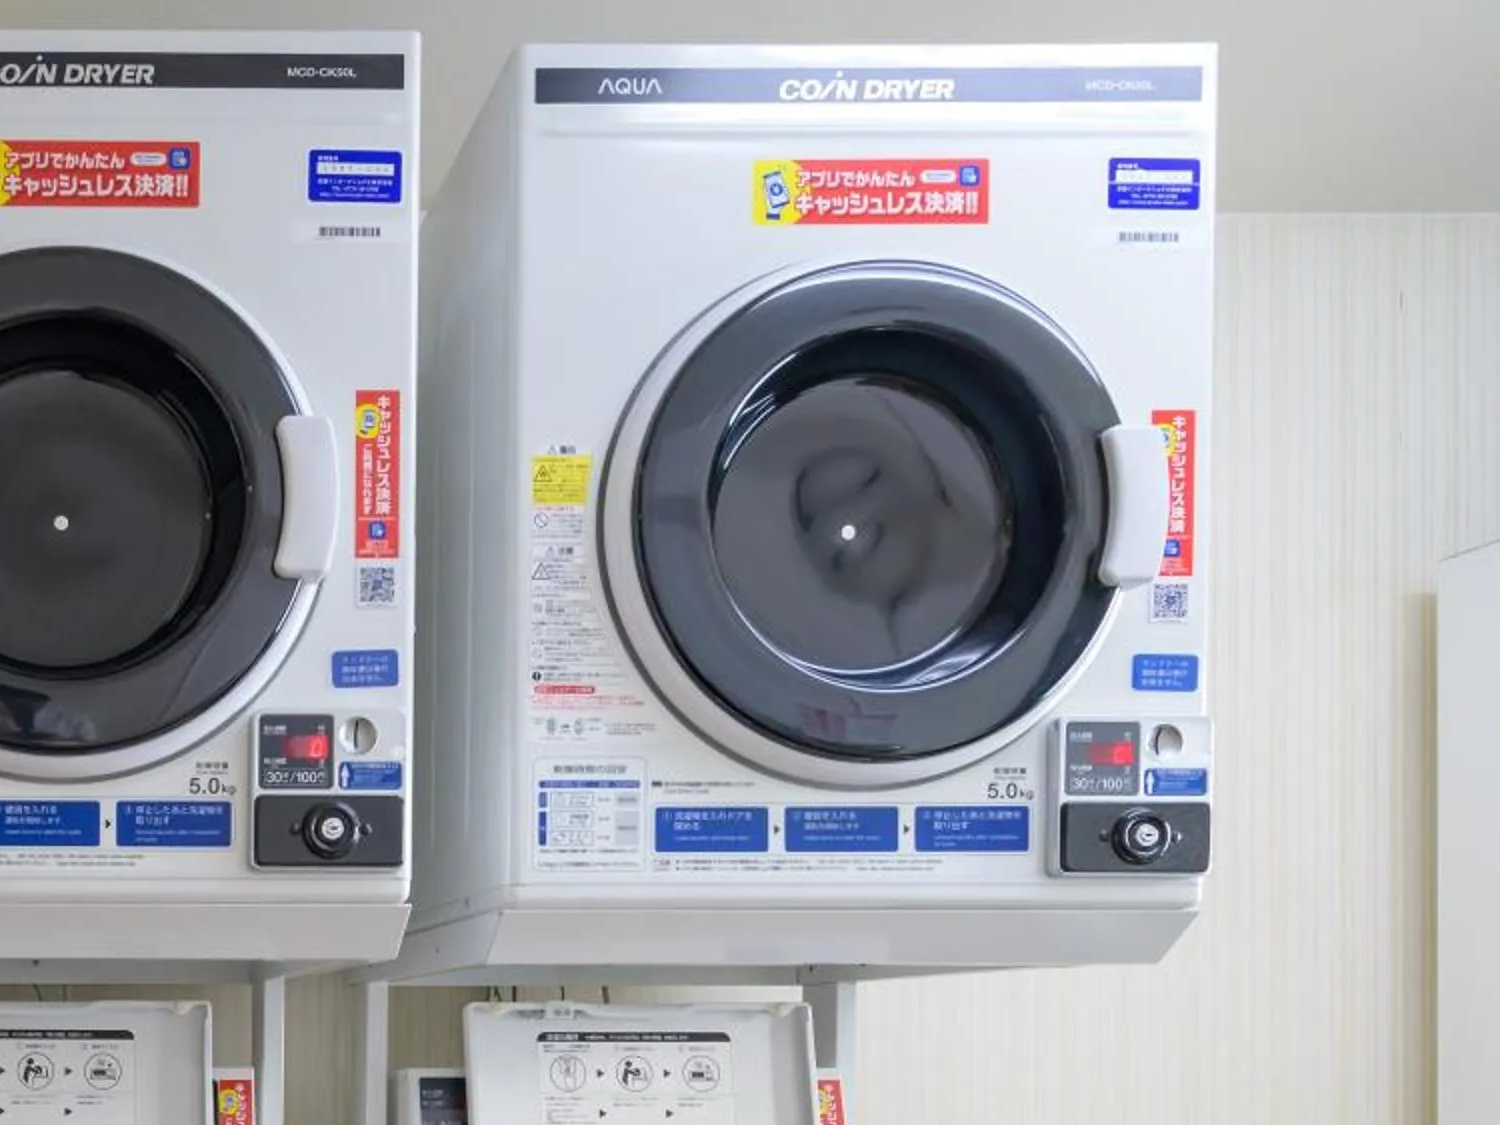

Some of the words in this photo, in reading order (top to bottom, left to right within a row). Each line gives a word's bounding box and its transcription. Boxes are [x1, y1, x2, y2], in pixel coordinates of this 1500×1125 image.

[63, 64, 156, 85] DRYER
[597, 78, 664, 95] AQUA
[778, 70, 858, 101] COIN
[862, 79, 955, 100] DRYER
[3, 151, 125, 169] アプリでかんたん
[796, 170, 915, 187] アプリでかんたん
